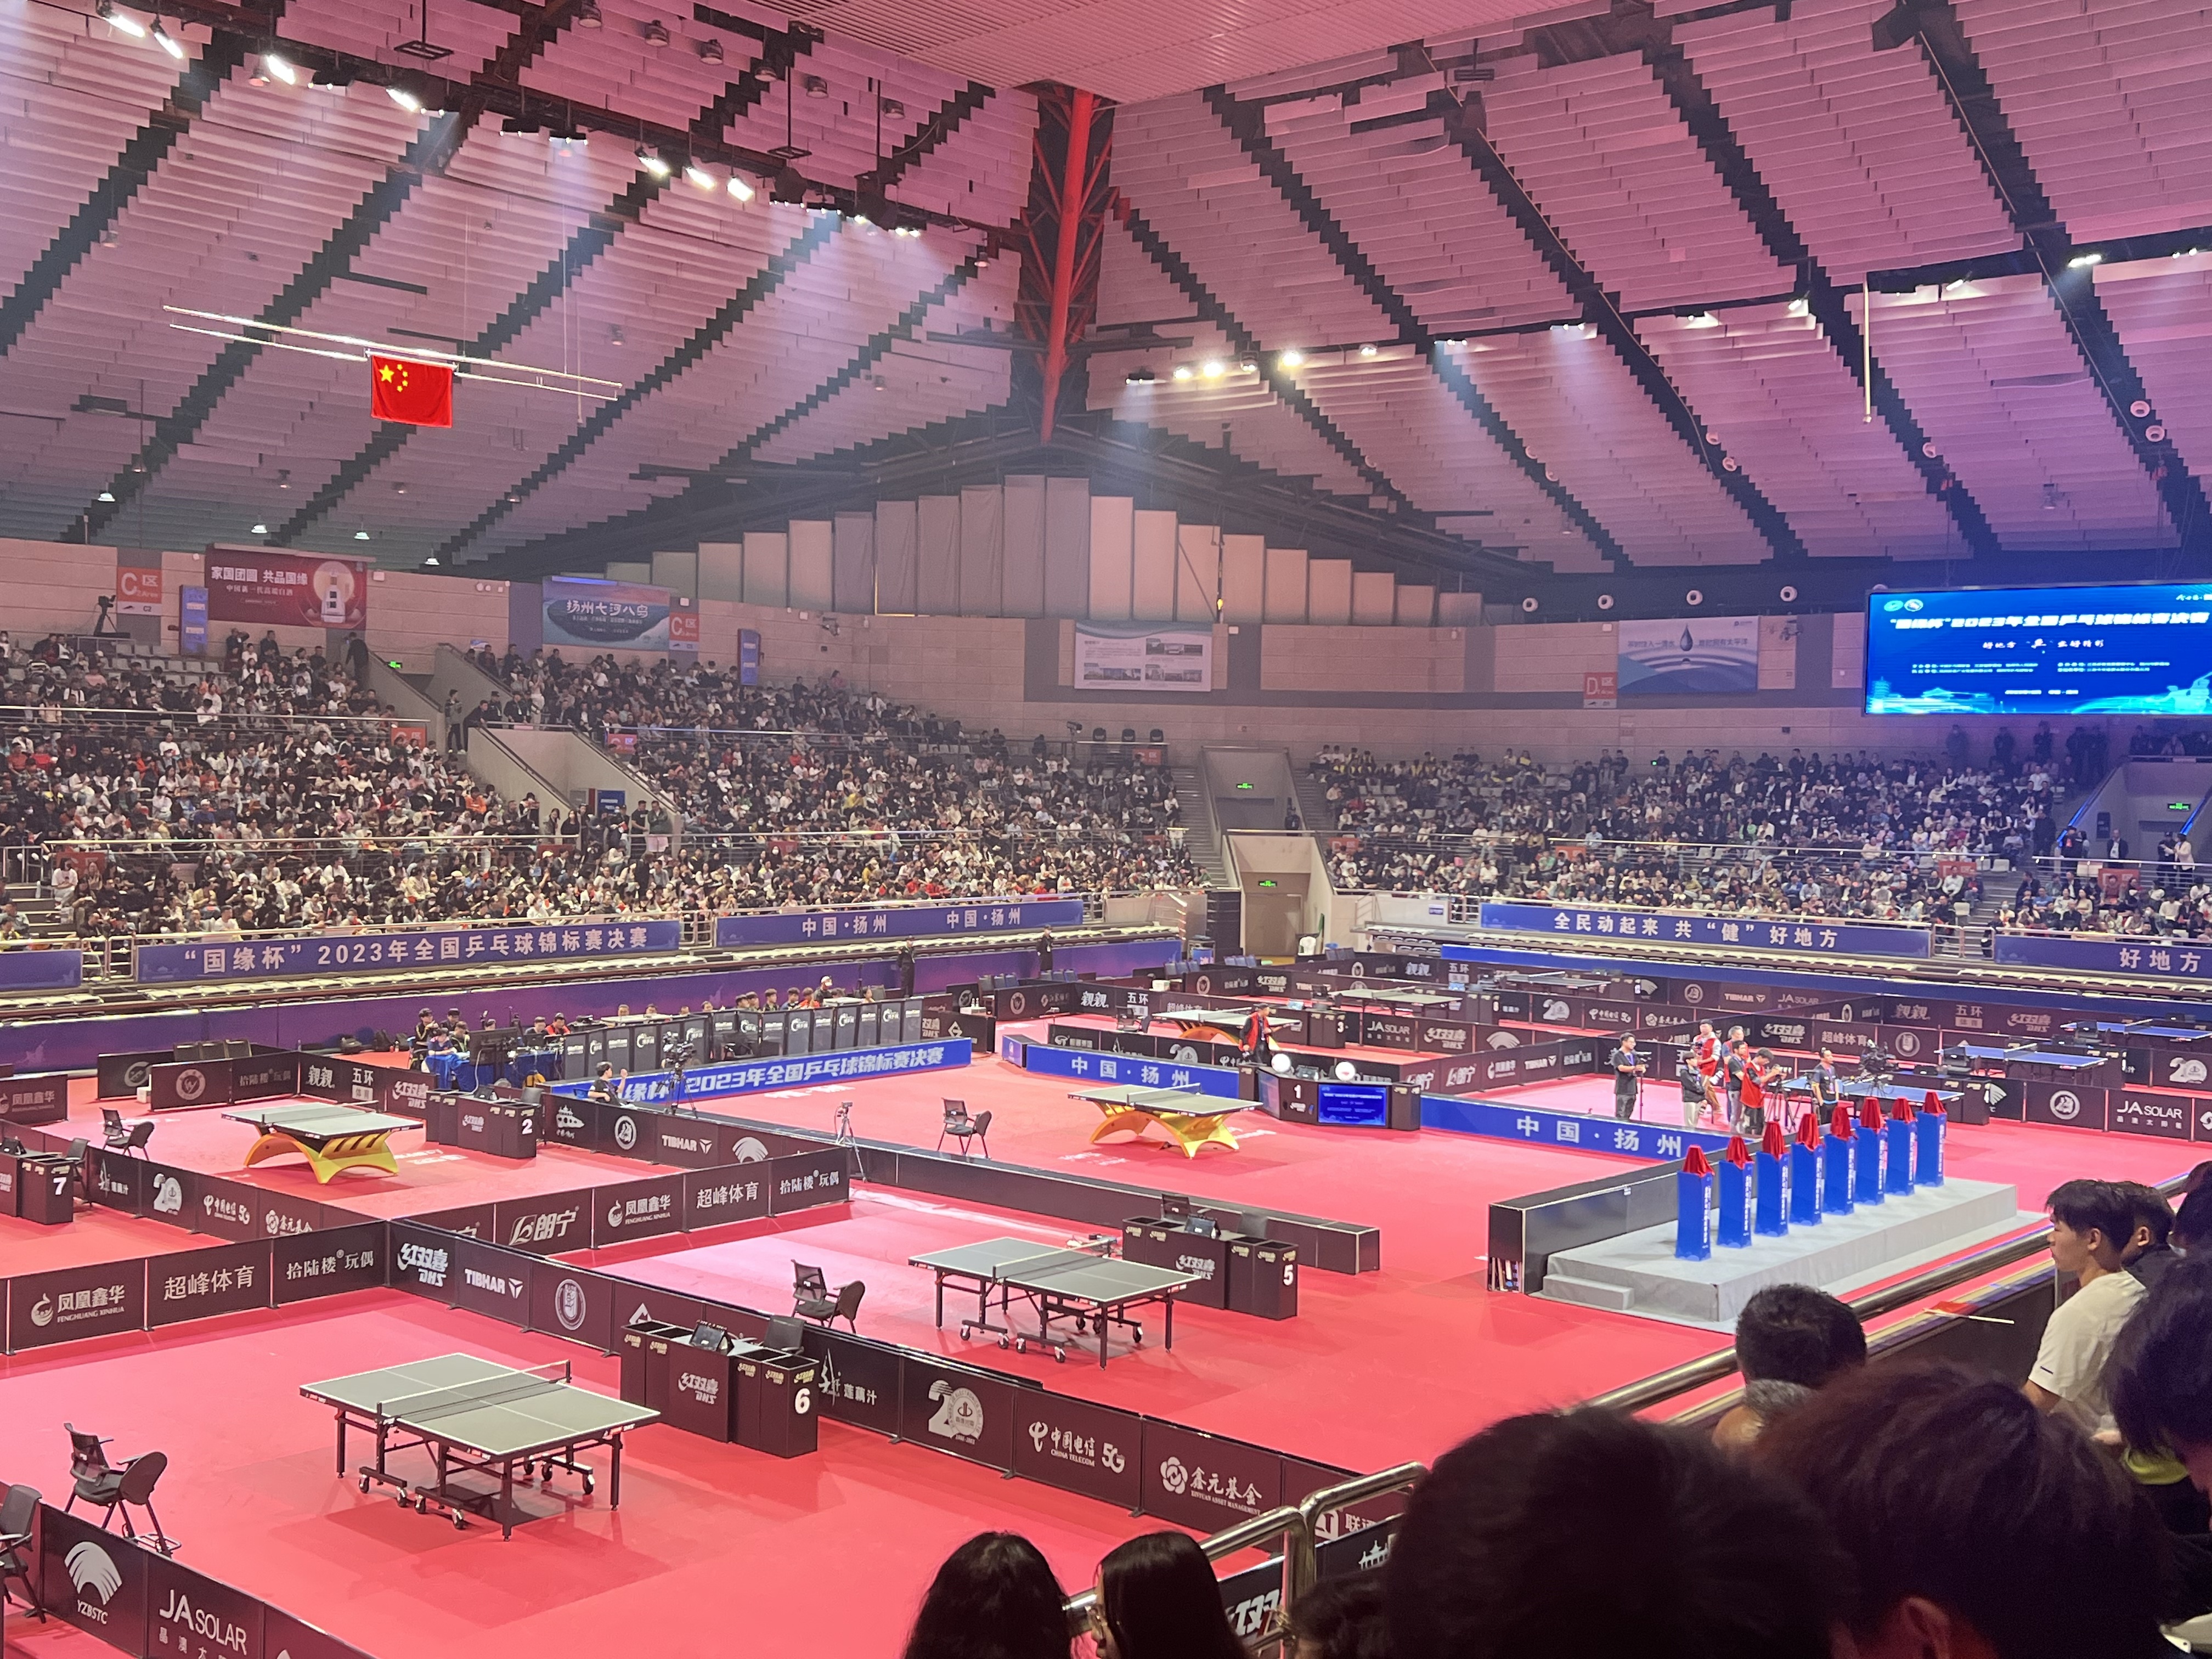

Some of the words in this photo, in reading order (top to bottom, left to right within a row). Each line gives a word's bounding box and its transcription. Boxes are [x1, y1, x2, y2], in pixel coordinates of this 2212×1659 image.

[802, 915, 888, 938] 中国·扬州
[946, 907, 1021, 929] 中国·扬州
[1553, 912, 1660, 936] 全民动起来
[1675, 919, 1838, 948] 共“健”好地方
[184, 927, 647, 974] “国缘杯”2023年全国乒乓球锦标赛决赛
[2119, 947, 2202, 973] 好地方
[1127, 992, 1149, 1005] 五环
[1955, 1005, 1983, 1017] 五环
[1367, 1021, 1384, 1031] JA
[352, 1067, 374, 1086] 五环
[1071, 1056, 1190, 1087] 中国·扬州
[1294, 1085, 1301, 1098] 1
[2117, 1100, 2143, 1115] JA
[2143, 1105, 2182, 1119] SOLAR
[522, 1119, 533, 1135] 2
[1517, 1116, 1681, 1157] 中国·扬州
[662, 1134, 697, 1152] TIBHAR
[53, 1177, 67, 1195] 7
[696, 1181, 760, 1209] 超峰体育
[625, 1194, 671, 1216] 凤凰鑫华
[397, 1243, 449, 1273] 红双喜
[163, 1265, 255, 1300] 超峰体育
[418, 1268, 447, 1288] DHS
[464, 1268, 506, 1295] TIBHAR
[1283, 1264, 1294, 1286] 5
[57, 1285, 125, 1313] 凤凰鑫华
[794, 1388, 811, 1414] 6
[843, 1383, 877, 1406] 莲藕汁
[1051, 1427, 1096, 1457] 中国电信
[1102, 1442, 1125, 1474] 5G
[1190, 1466, 1262, 1505] 鑫元基金
[77, 1599, 109, 1624] YZBSTC
[159, 1589, 194, 1630] JA
[195, 1609, 247, 1656] SOLAR
